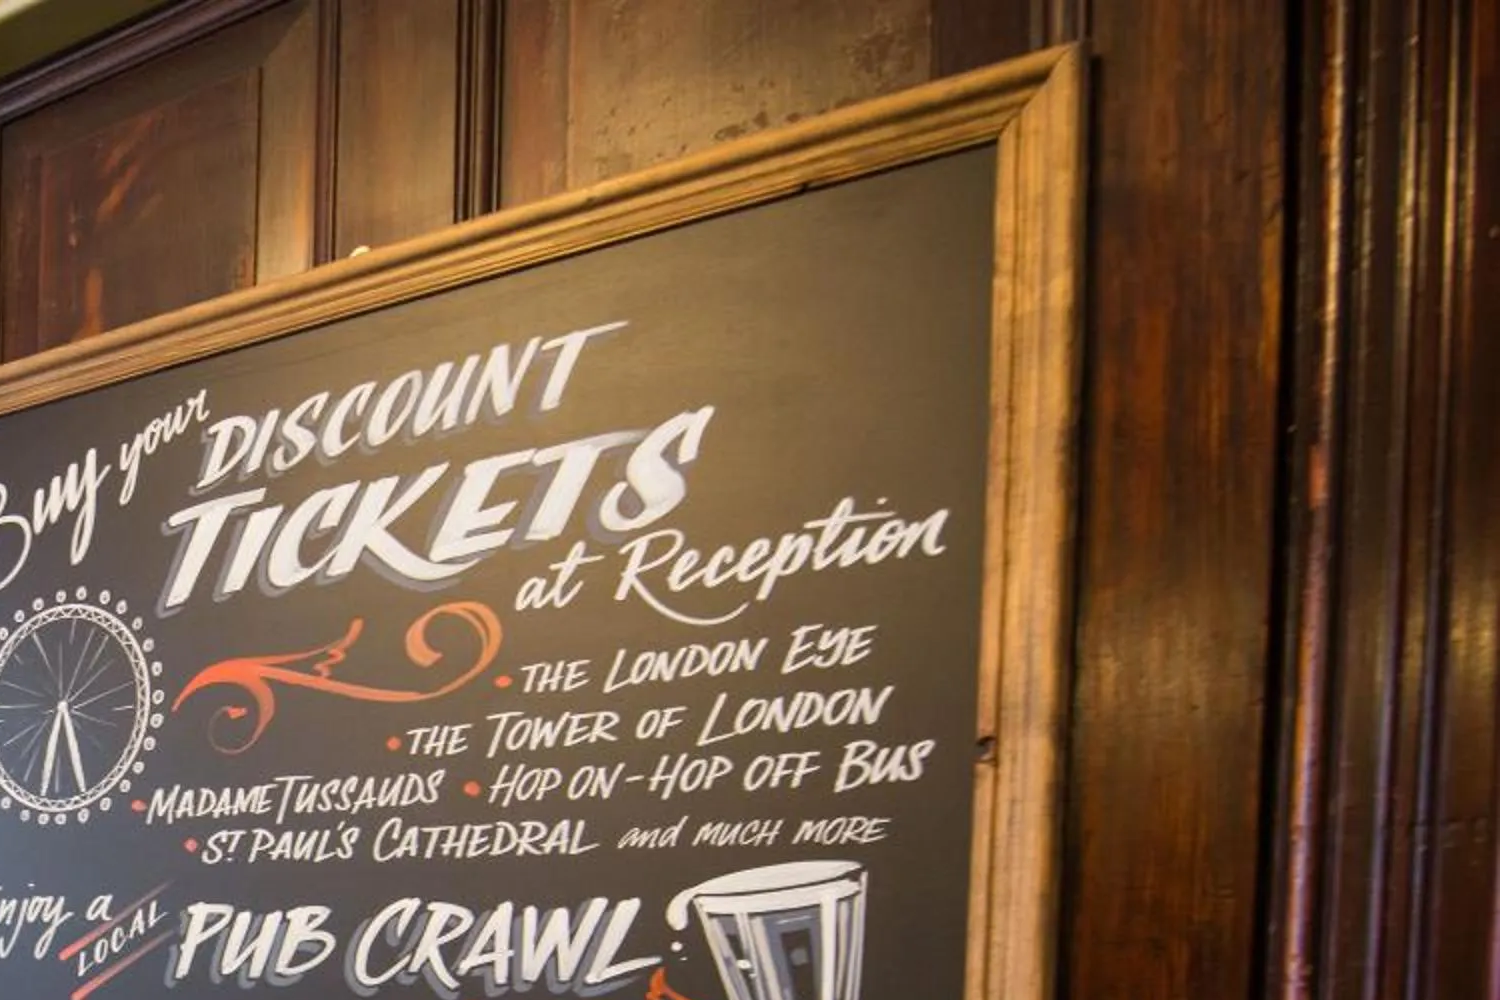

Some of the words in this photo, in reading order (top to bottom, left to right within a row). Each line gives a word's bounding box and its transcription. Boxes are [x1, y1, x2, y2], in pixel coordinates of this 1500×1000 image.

[197, 320, 630, 490] DISCOUNT
[119, 390, 210, 506] your
[160, 404, 715, 608] TICKETS
[515, 541, 604, 612] at
[614, 497, 950, 627] Reception
[521, 659, 591, 693] THE
[603, 637, 768, 694] LONDON
[407, 723, 472, 757] THE
[484, 711, 620, 758] TOWER
[636, 705, 688, 740] OF
[696, 685, 896, 747] LONDON
[146, 784, 278, 824] MADAME
[274, 769, 446, 825] TUSSAUDS
[488, 764, 563, 806] HOP
[743, 751, 821, 792] OFF
[248, 820, 361, 864] PAUL'S
[372, 816, 599, 862] CATHEDRAL
[617, 816, 690, 850] and
[692, 819, 784, 847] MUCH
[792, 816, 892, 845] MORE
[77, 900, 170, 977] LOCAL
[85, 892, 114, 922] a
[172, 901, 337, 980] PUB
[353, 897, 663, 990] CRAWL
